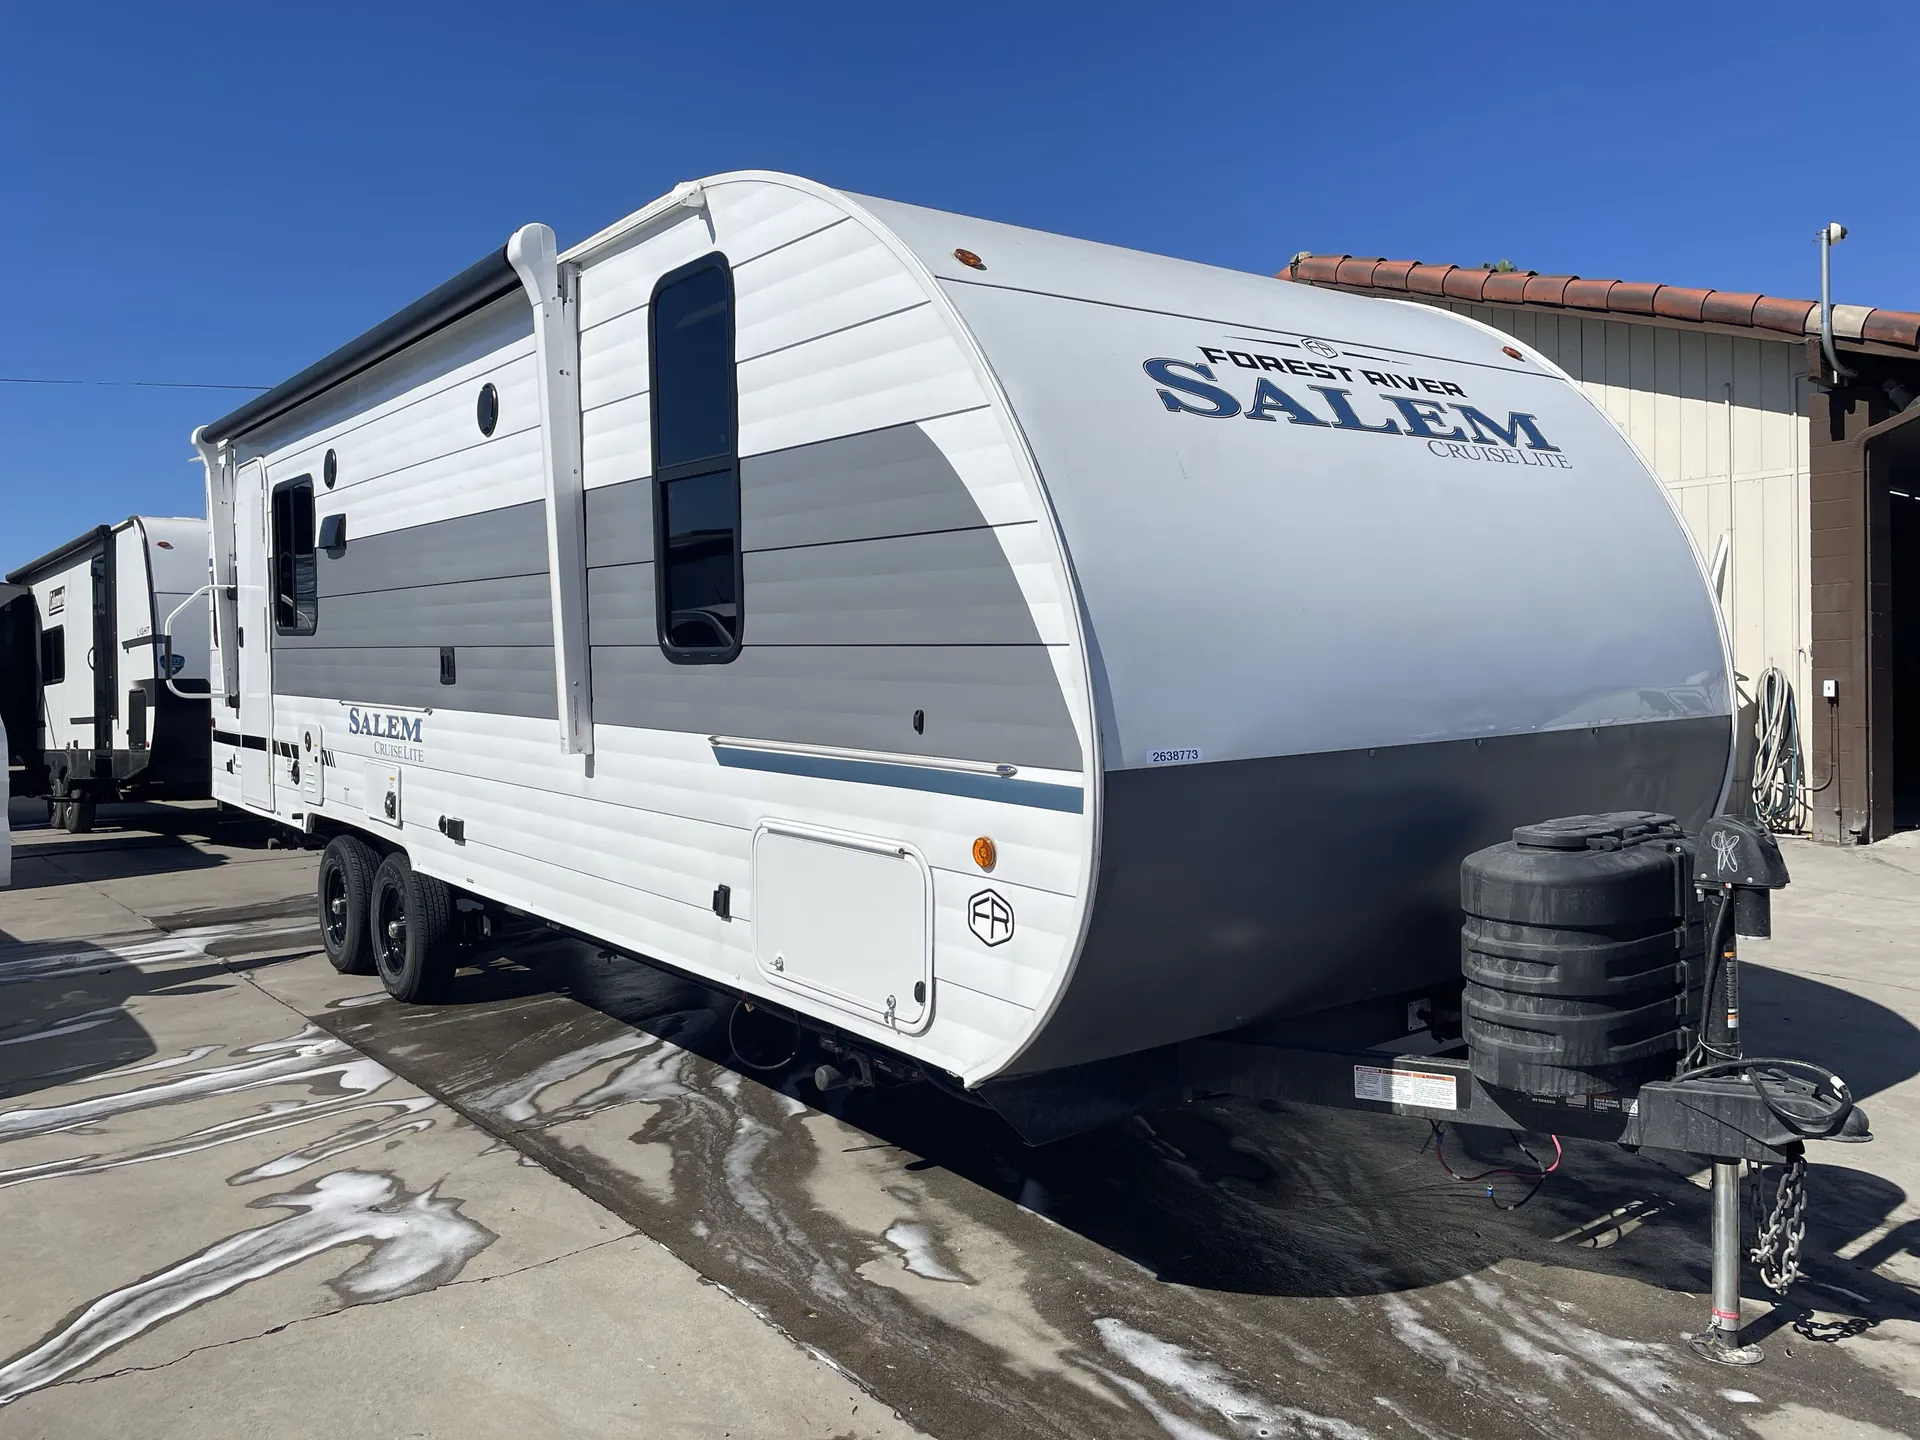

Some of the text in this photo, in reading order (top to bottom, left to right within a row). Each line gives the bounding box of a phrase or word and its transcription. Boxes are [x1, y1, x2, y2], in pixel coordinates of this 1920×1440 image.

[1196, 345, 1470, 398] FOREST RIVER
[1142, 356, 1562, 453] SALEM
[348, 707, 423, 743] SALEM
[1152, 749, 1199, 762] 2638773
[972, 895, 1010, 940] FR
